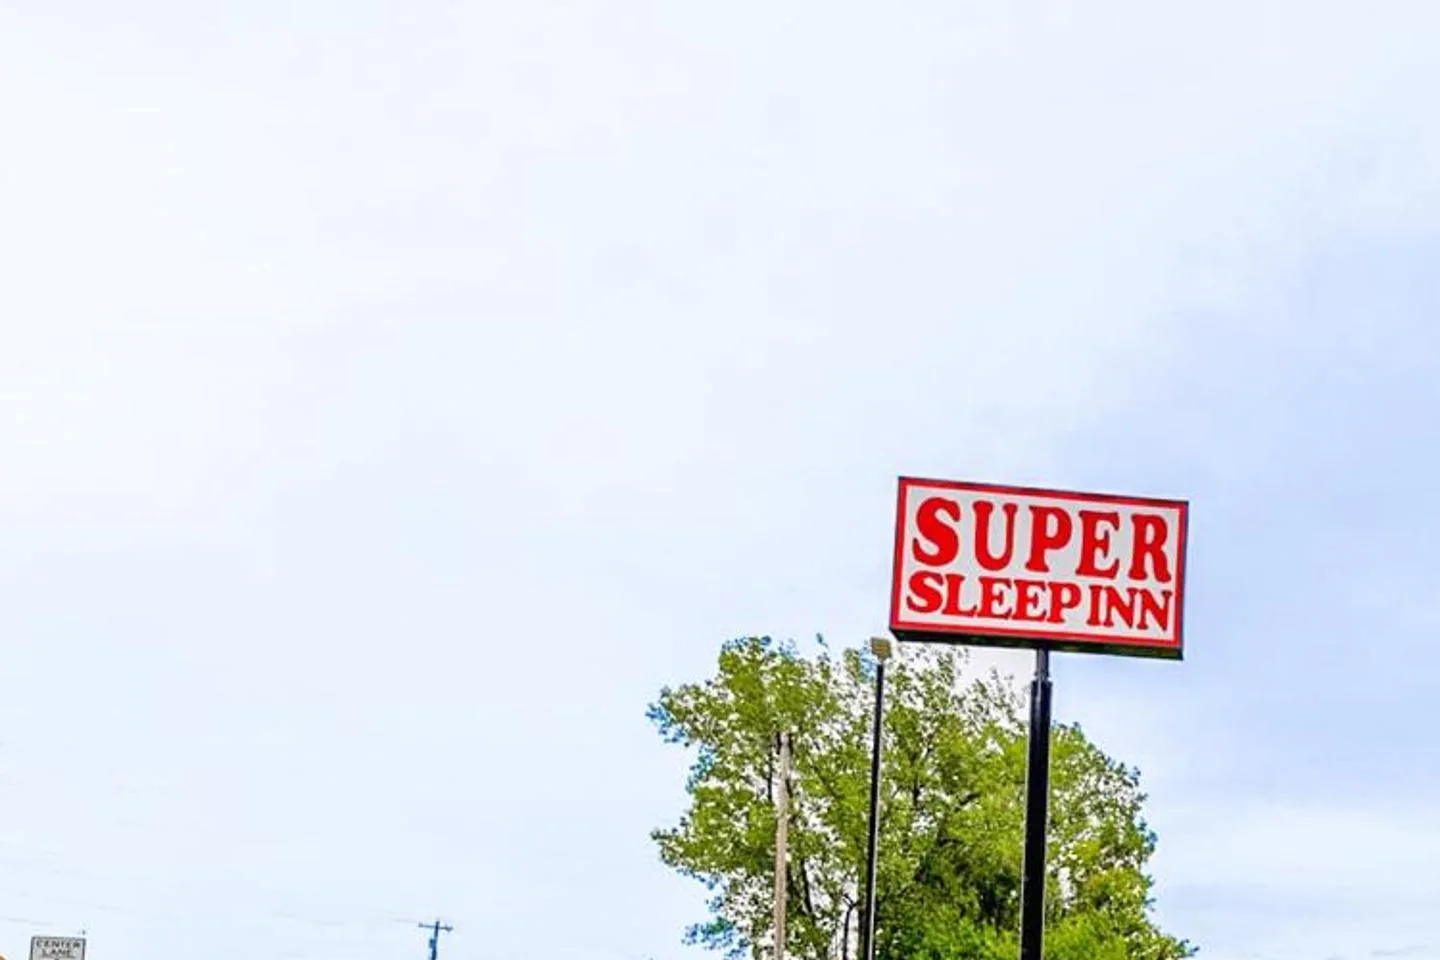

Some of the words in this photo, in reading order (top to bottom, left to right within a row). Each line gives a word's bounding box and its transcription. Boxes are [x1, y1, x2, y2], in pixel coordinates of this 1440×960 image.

[912, 496, 1172, 583] SUPER
[906, 570, 1082, 623] SLEEP
[1086, 584, 1172, 632] INN
[36, 940, 81, 949] CENTER
[41, 949, 74, 958] LANE
